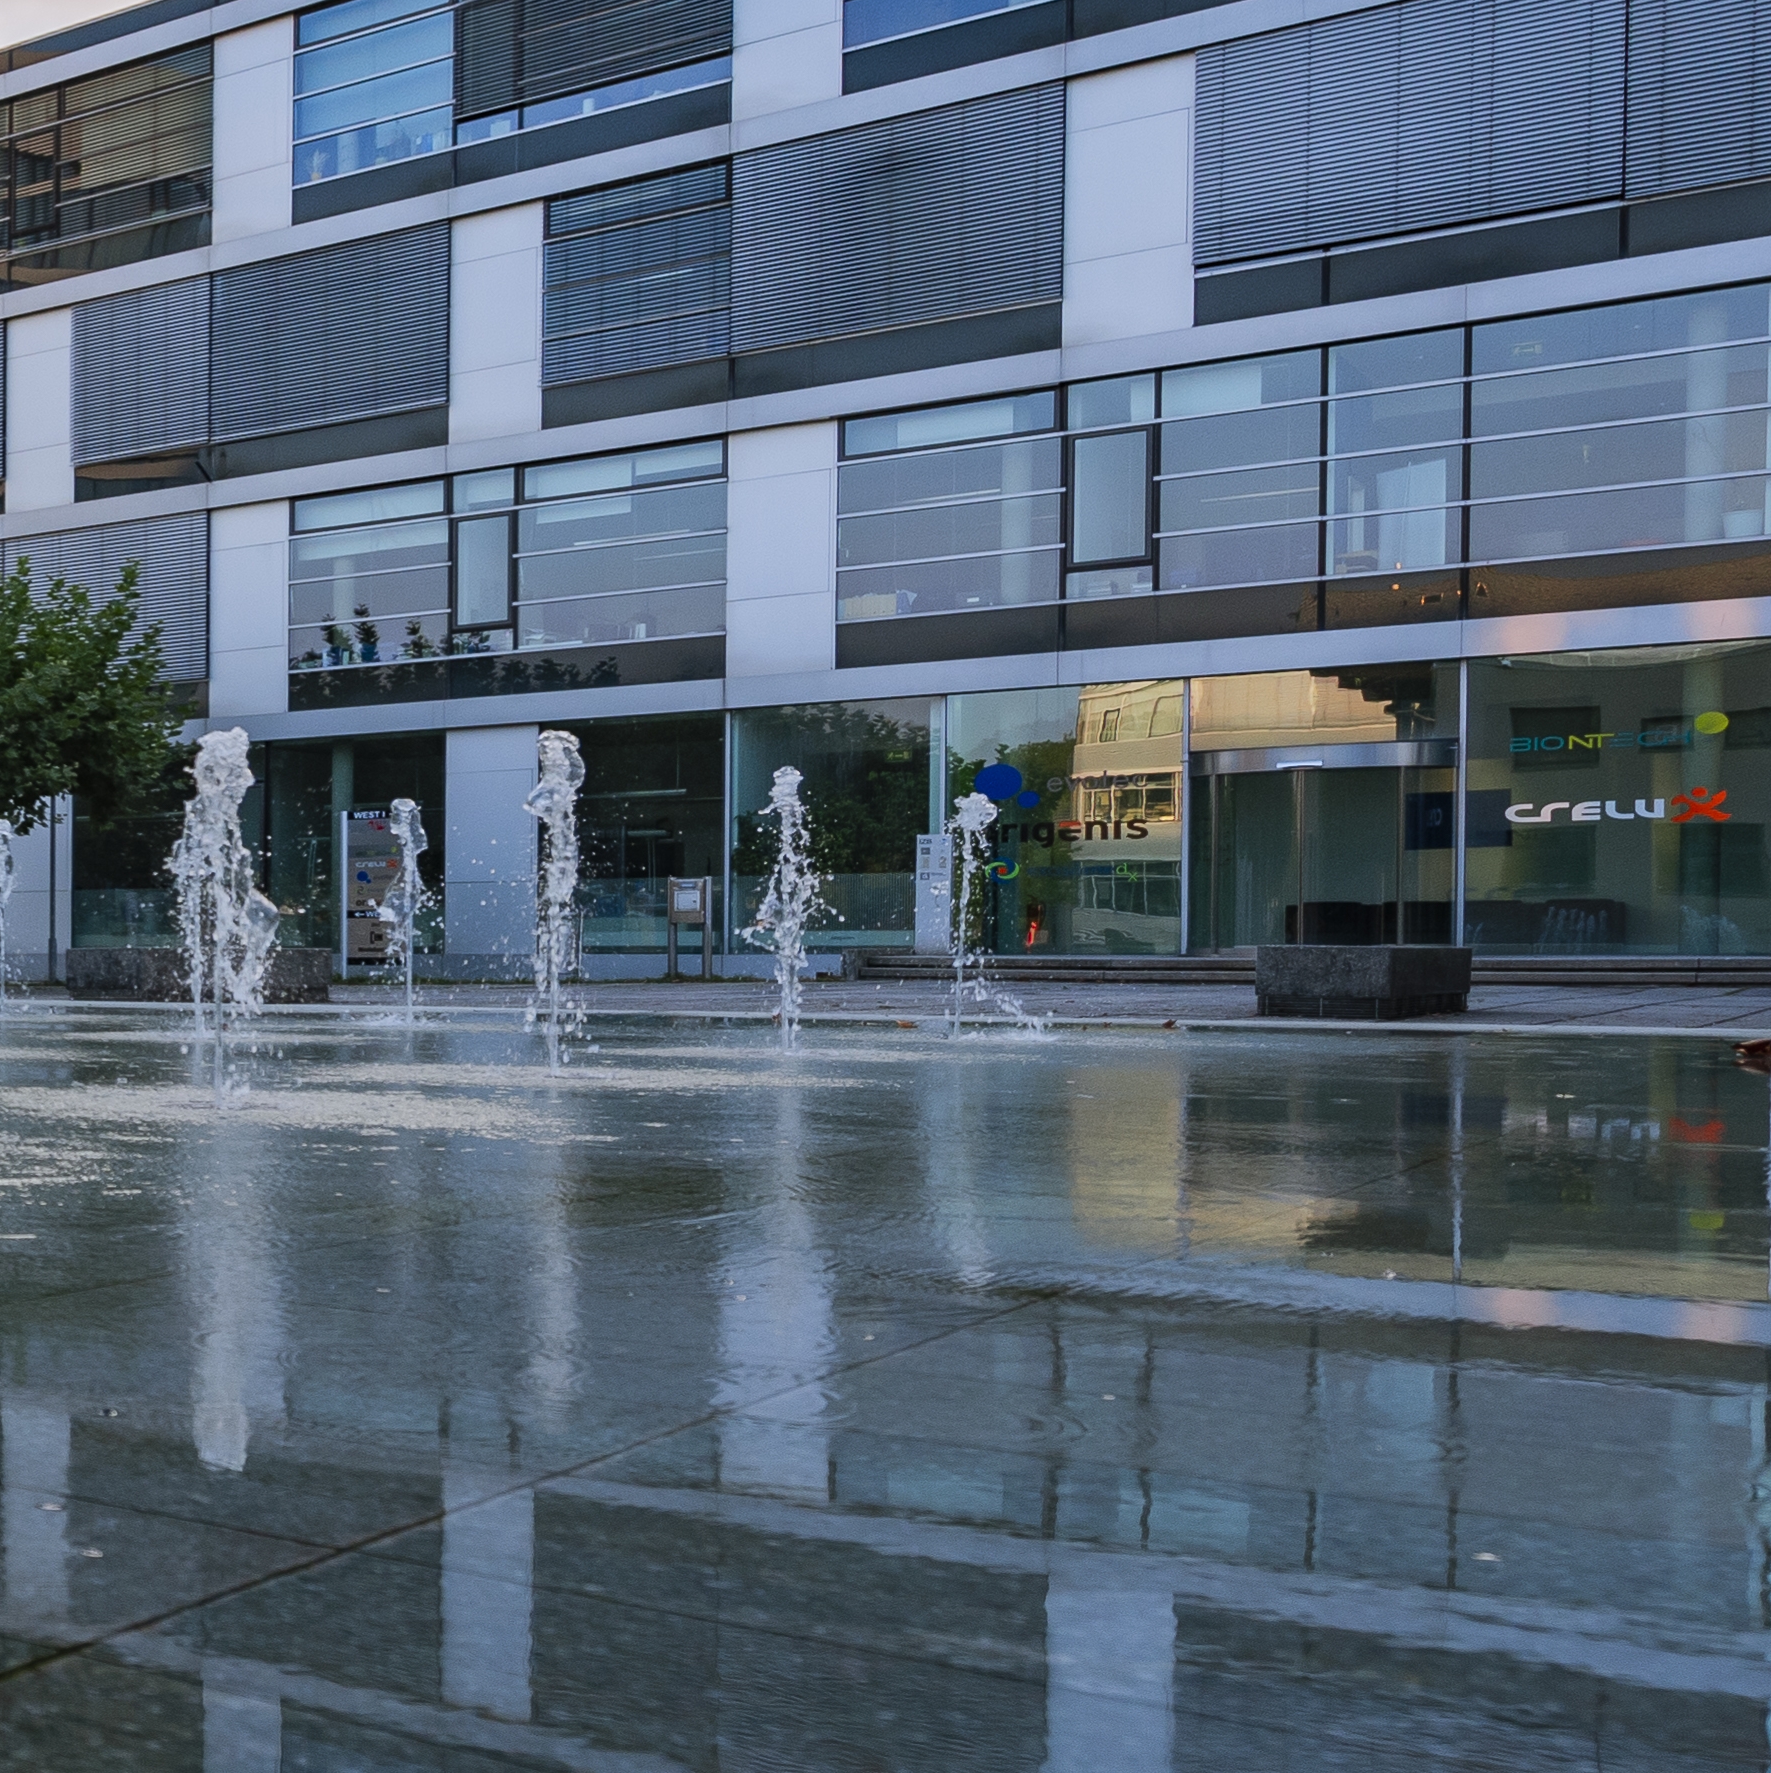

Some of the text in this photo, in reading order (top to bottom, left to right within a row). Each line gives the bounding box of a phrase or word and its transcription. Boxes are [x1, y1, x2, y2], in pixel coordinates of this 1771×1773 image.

[1509, 730, 1691, 753] BIONTECH
[1046, 770, 1150, 793] evotec
[354, 811, 380, 819] WEST
[988, 818, 1149, 848] rigenis
